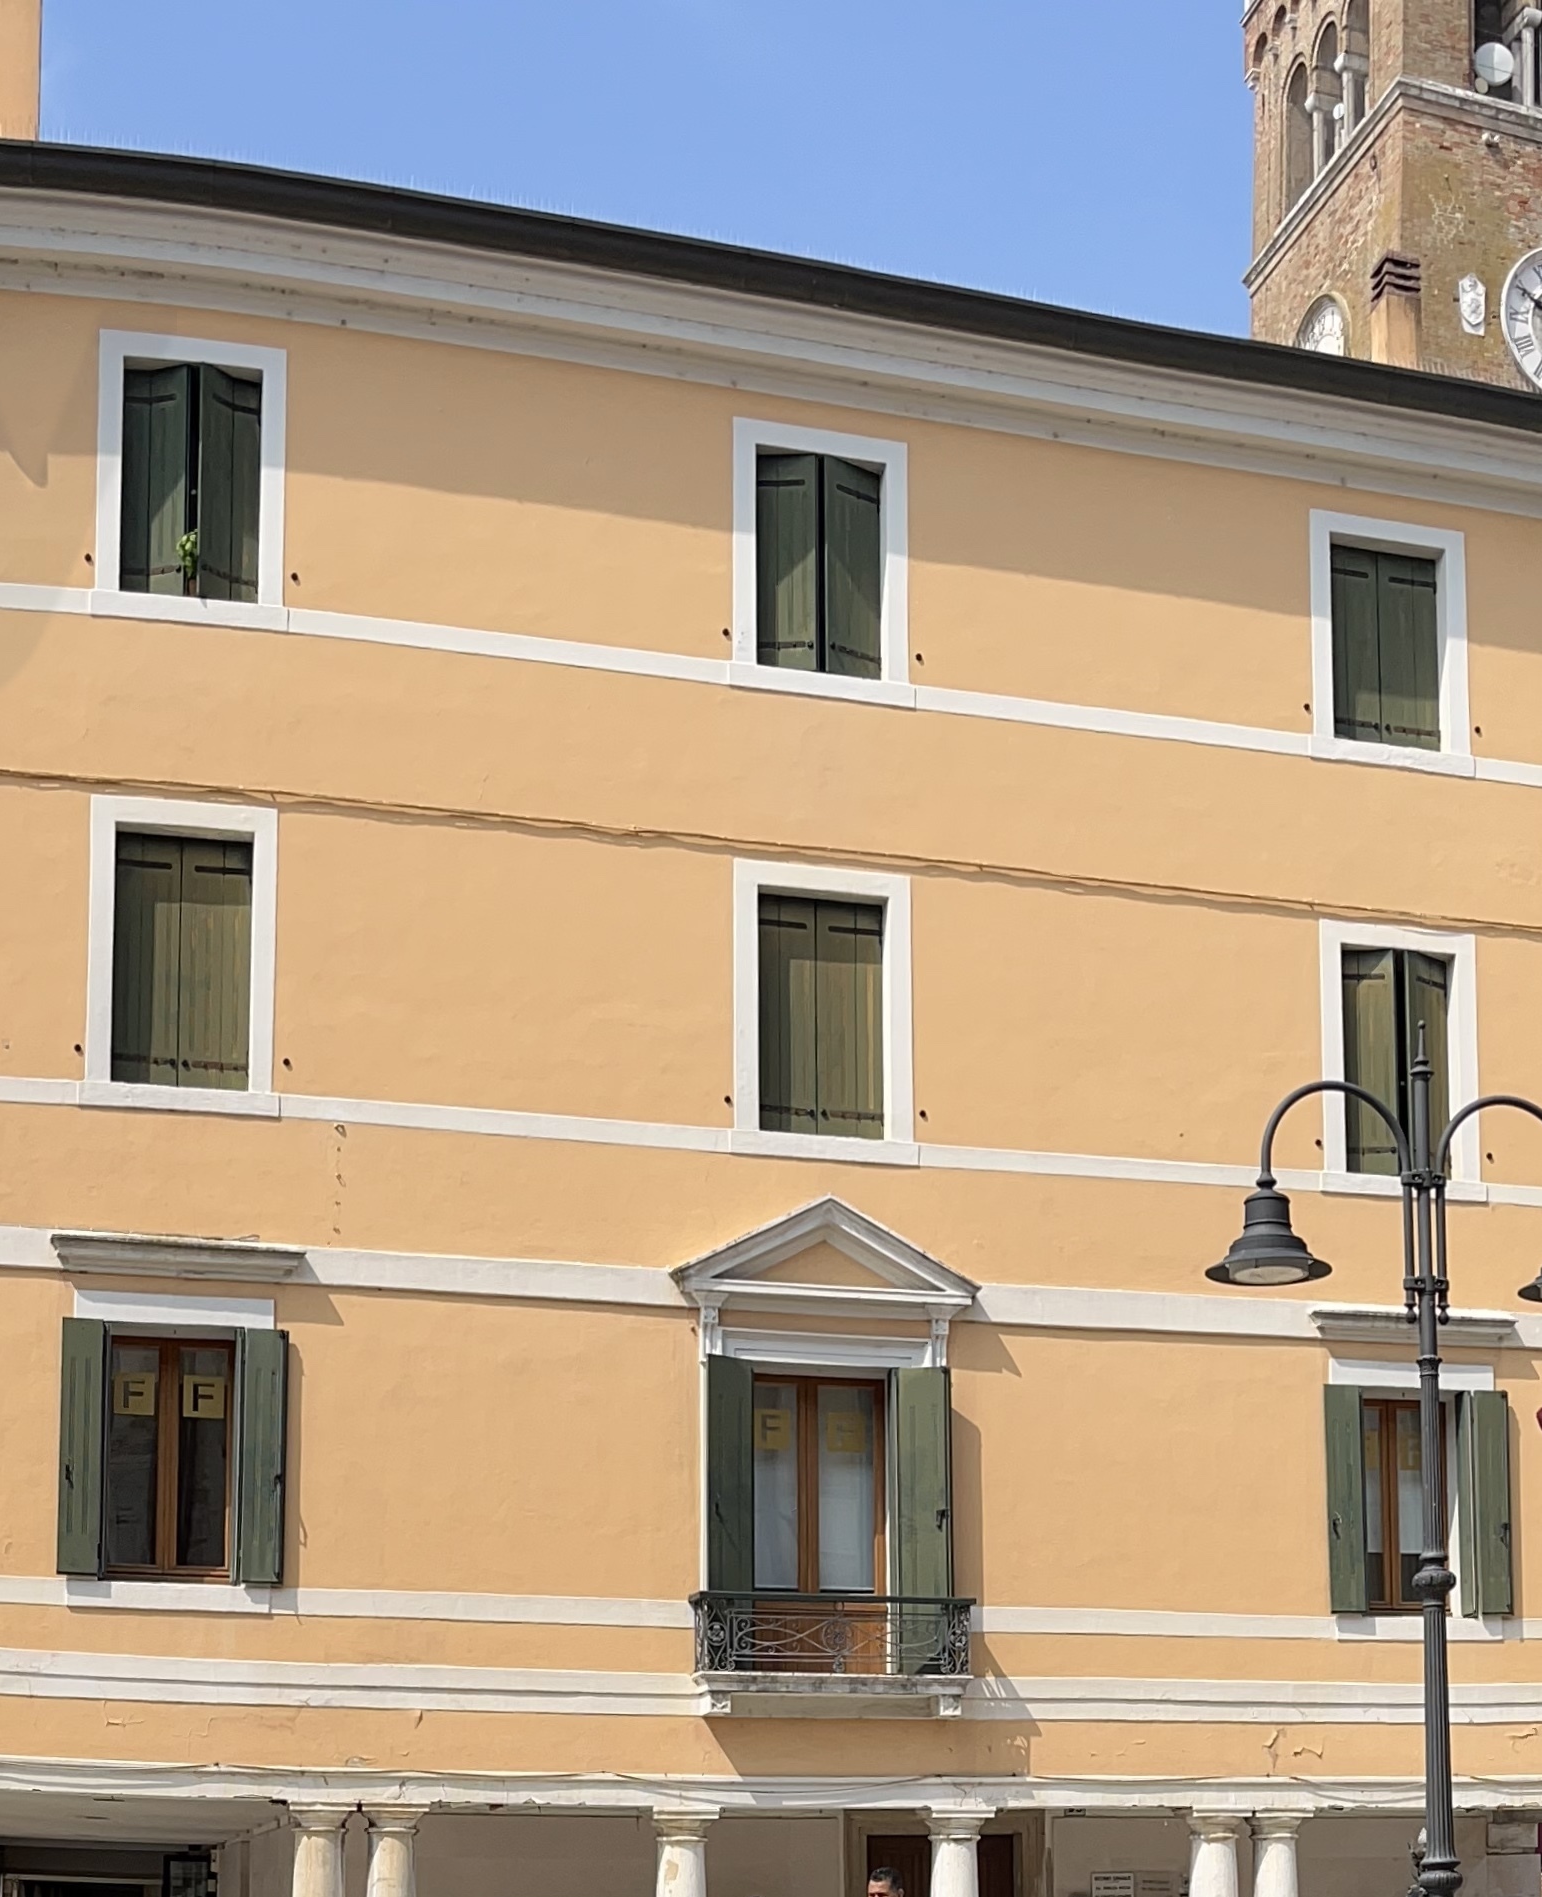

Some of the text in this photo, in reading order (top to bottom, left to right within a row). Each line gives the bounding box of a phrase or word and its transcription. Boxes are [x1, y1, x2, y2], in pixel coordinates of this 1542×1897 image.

[123, 1380, 146, 1409] F
[192, 1383, 215, 1412] F
[760, 1413, 784, 1443] F
